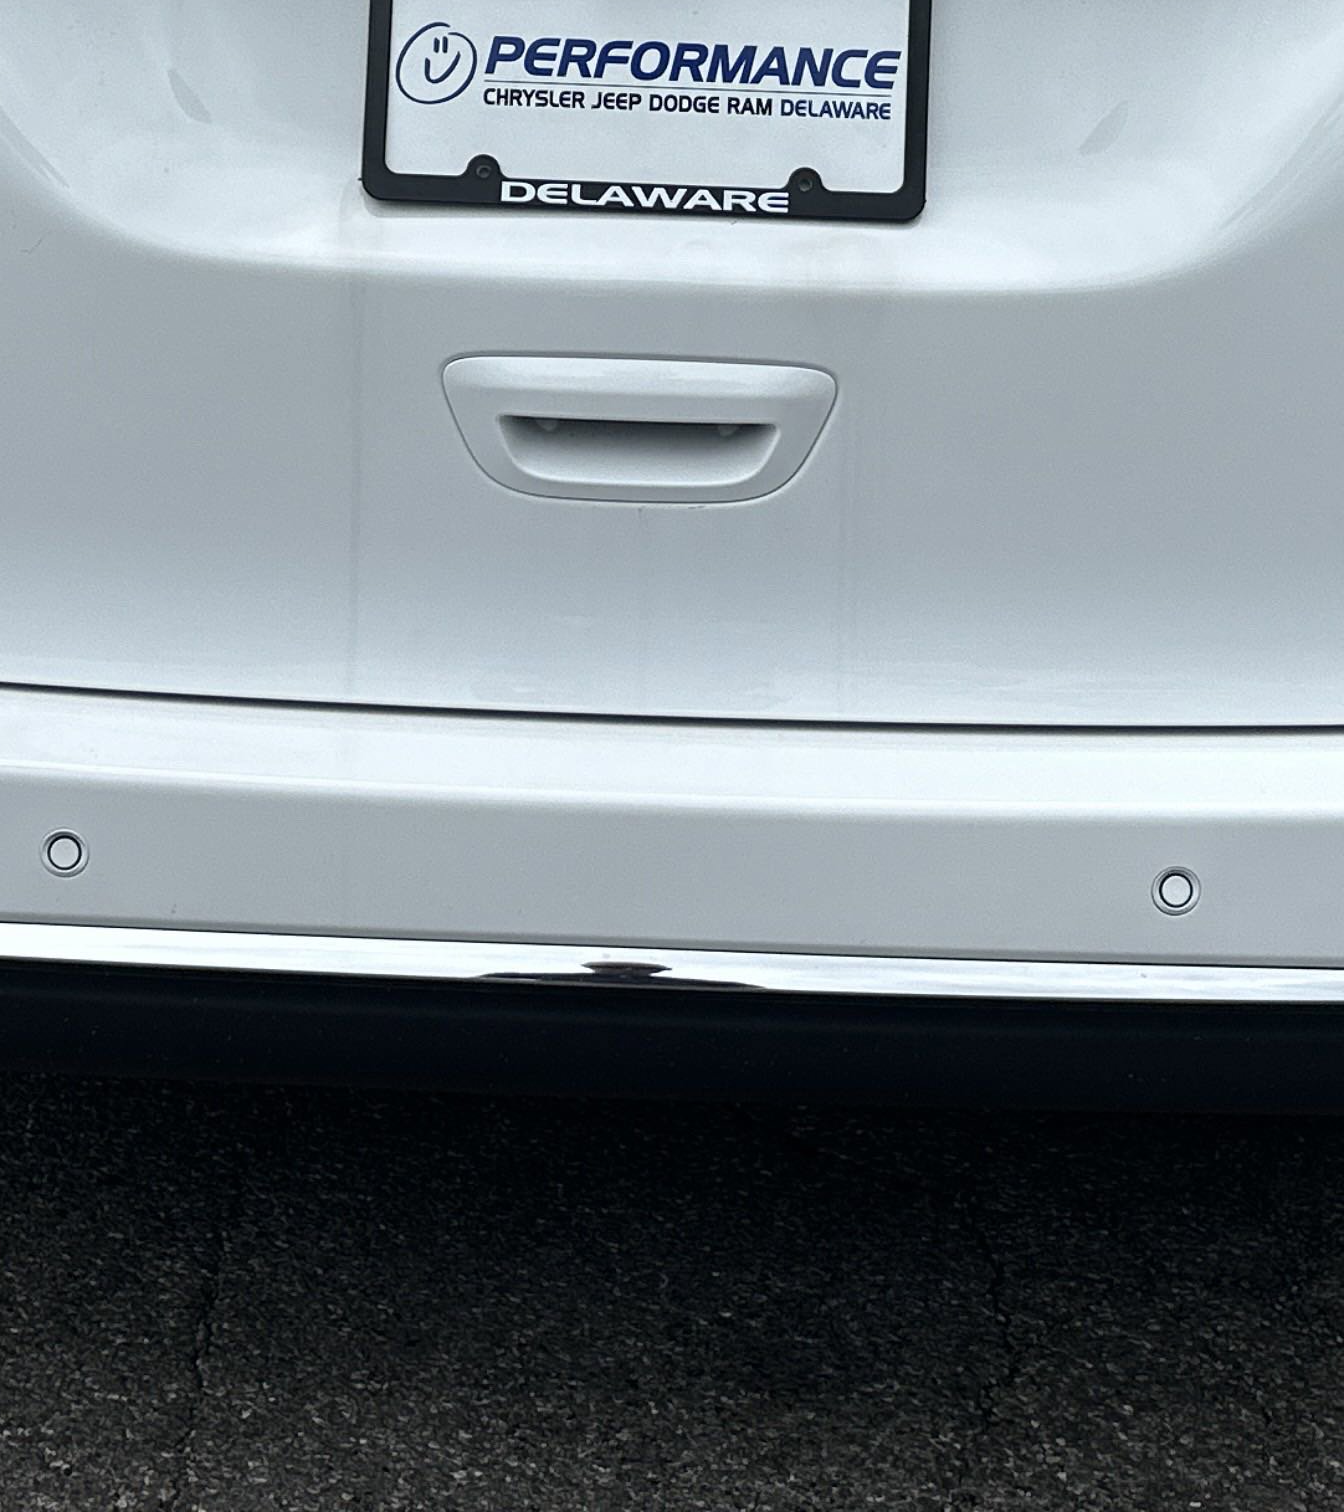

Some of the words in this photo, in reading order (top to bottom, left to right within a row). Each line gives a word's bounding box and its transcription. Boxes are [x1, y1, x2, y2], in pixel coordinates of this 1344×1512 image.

[484, 34, 903, 90] PERFORMANCE
[483, 87, 587, 110] CHRYSLER
[591, 93, 644, 113] JEEP
[649, 95, 721, 115] DODGE
[727, 98, 774, 117] RAM
[780, 100, 892, 121] DELAWARE
[500, 179, 791, 214] DELAWARE
